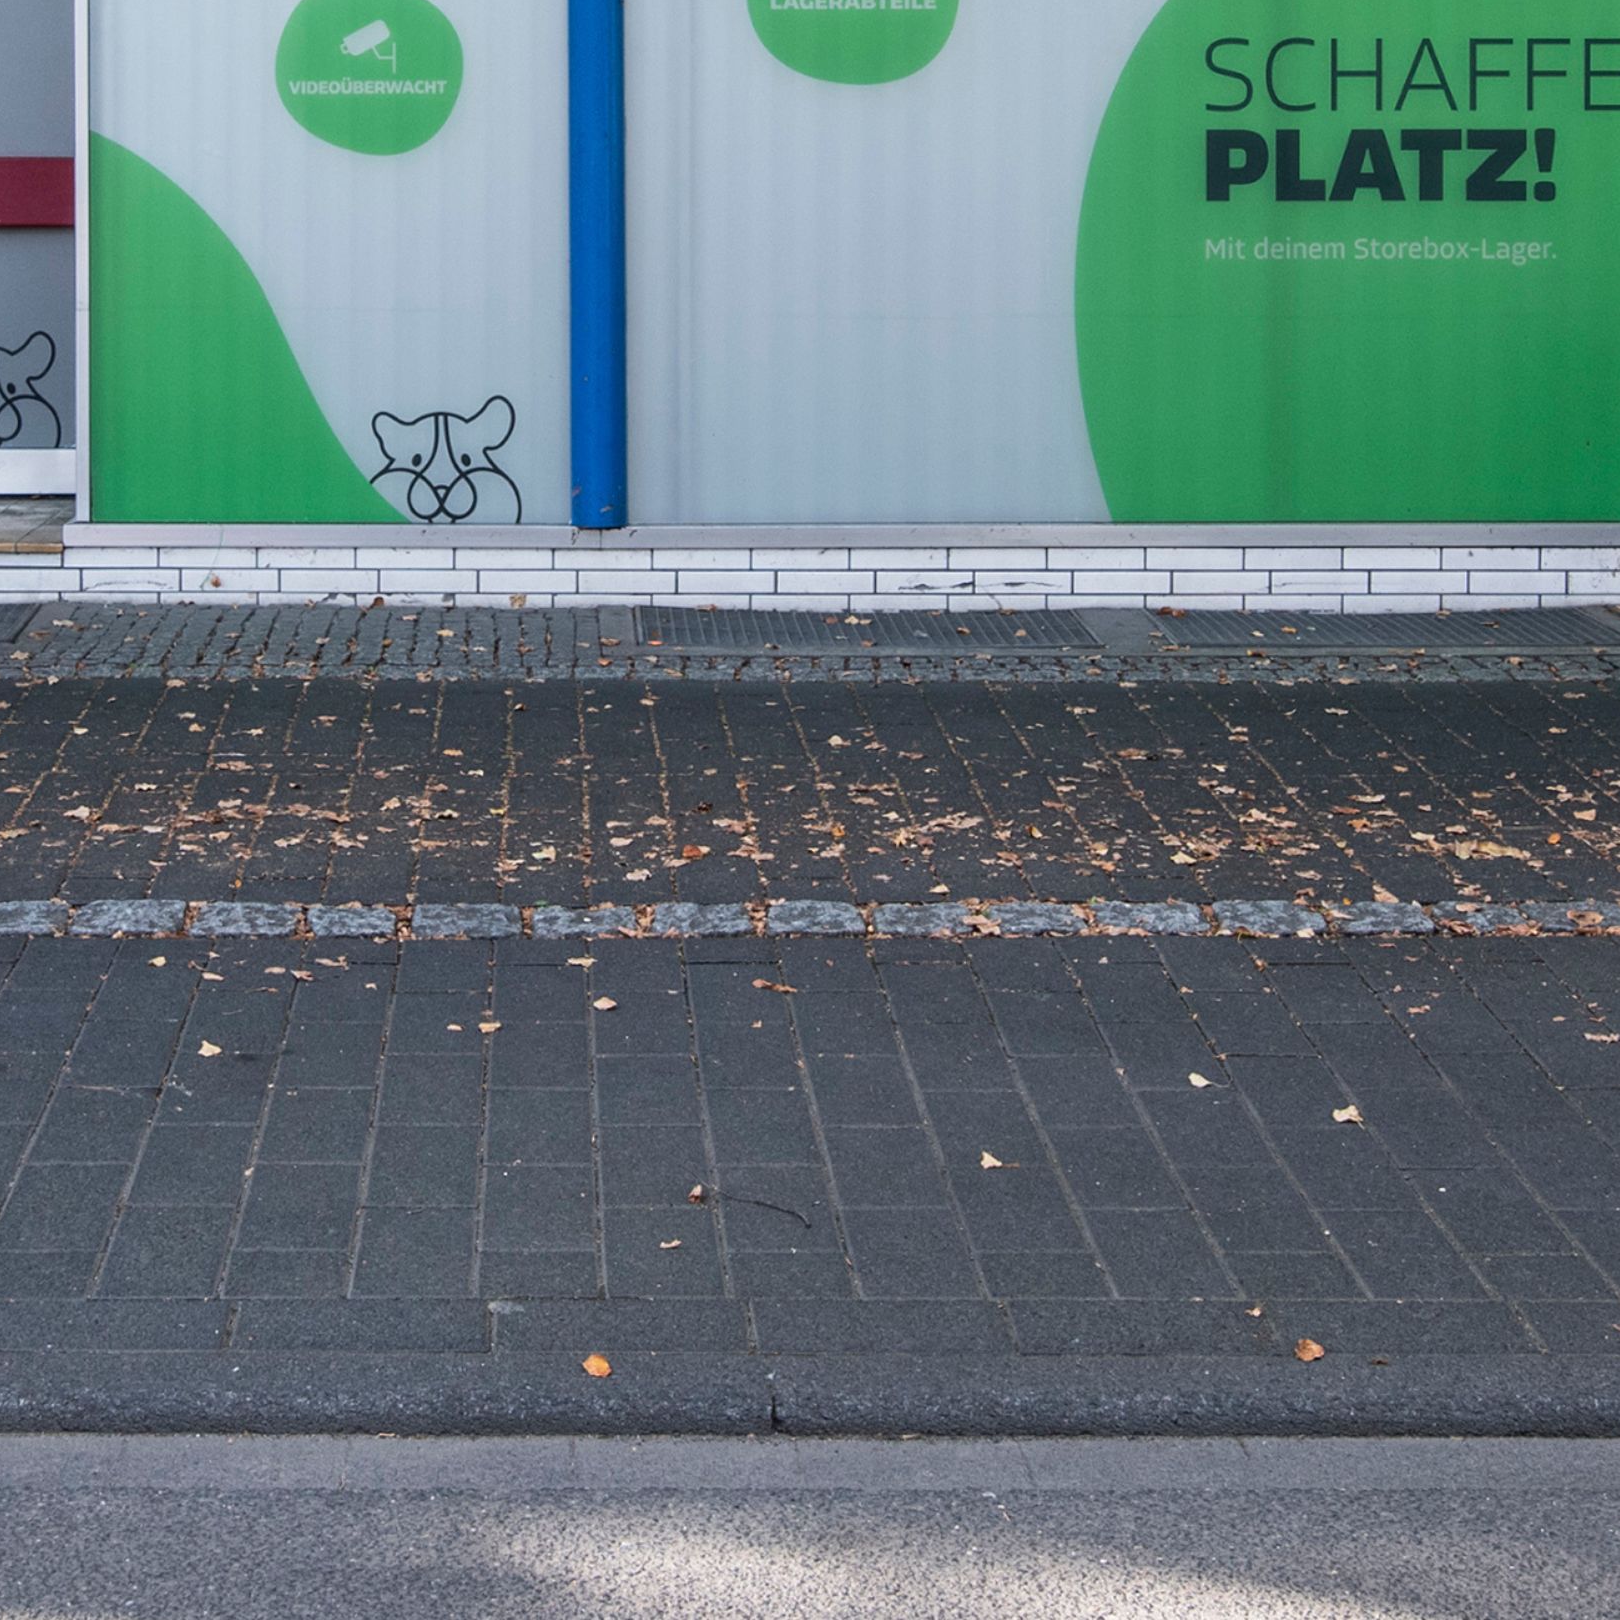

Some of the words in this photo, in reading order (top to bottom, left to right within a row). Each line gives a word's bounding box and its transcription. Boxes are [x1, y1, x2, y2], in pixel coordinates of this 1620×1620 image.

[288, 77, 447, 95] VIDEOÜBERWACHT
[1205, 127, 1557, 202] PLATZ!
[1205, 237, 1246, 260] Mit
[1254, 236, 1345, 260] deinem
[1353, 236, 1557, 267] Storebox-Lager.
